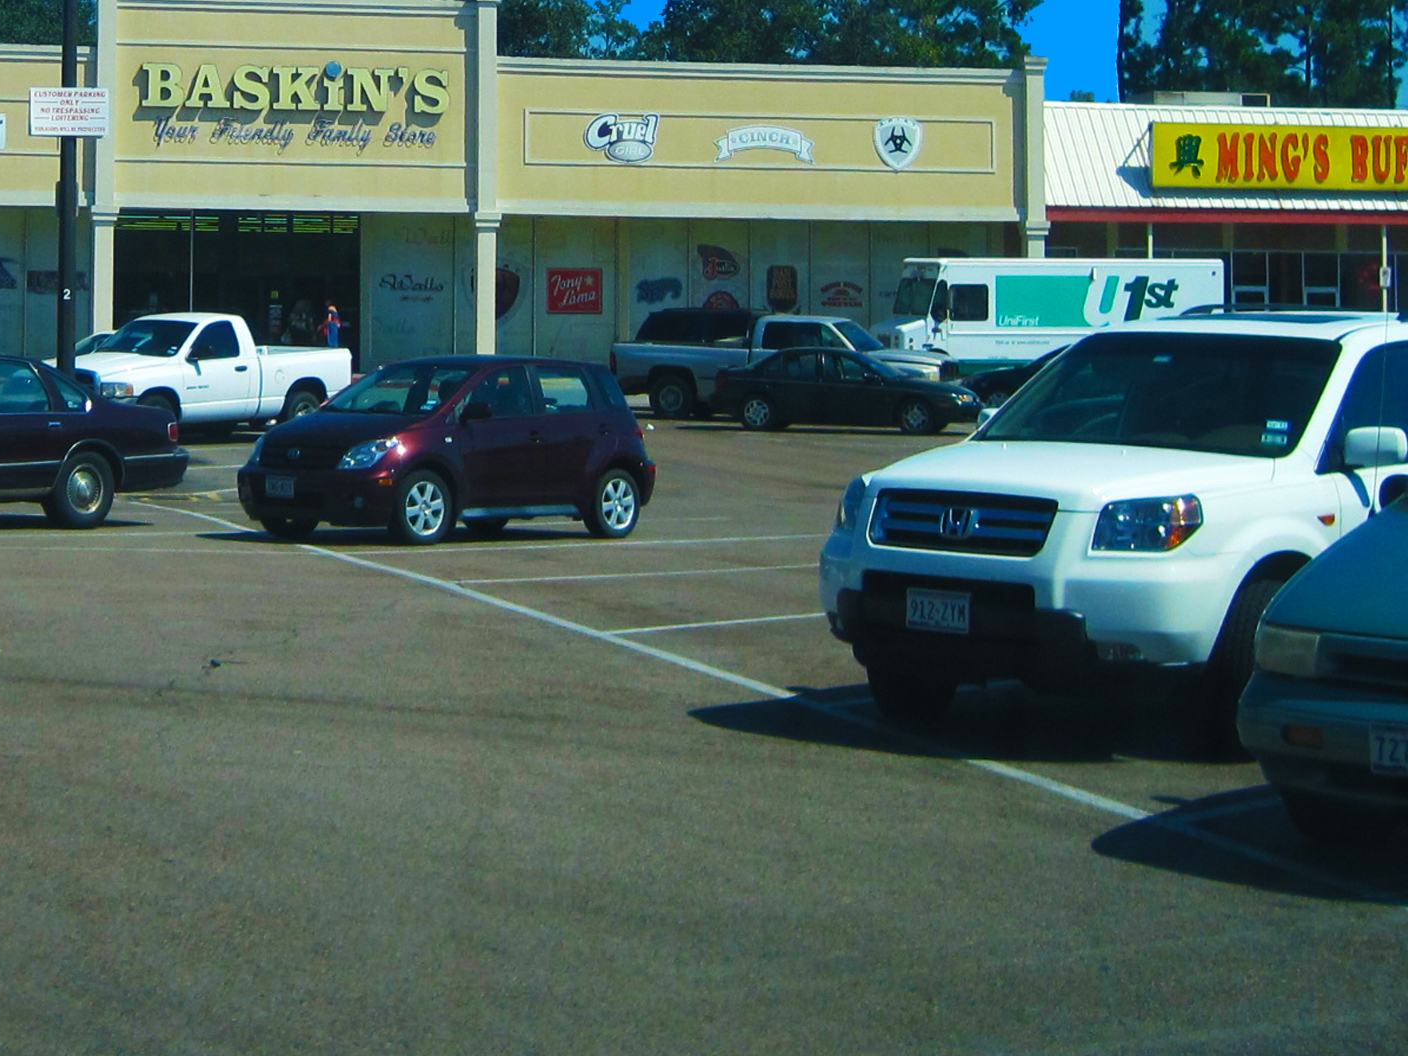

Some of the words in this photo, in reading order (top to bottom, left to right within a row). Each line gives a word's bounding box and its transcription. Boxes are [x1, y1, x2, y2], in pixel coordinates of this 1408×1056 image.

[153, 117, 200, 147] Your
[210, 115, 295, 154] Friendly
[307, 118, 372, 156] Family
[382, 121, 437, 148] Store
[586, 113, 659, 150] Cruel
[738, 131, 791, 145] CINCH
[614, 146, 647, 156] GIRL
[1215, 131, 1331, 184] MING'S
[551, 274, 584, 296] Tony
[63, 288, 71, 300] 2
[558, 290, 596, 307] Lama
[998, 315, 1040, 327] UniFirst
